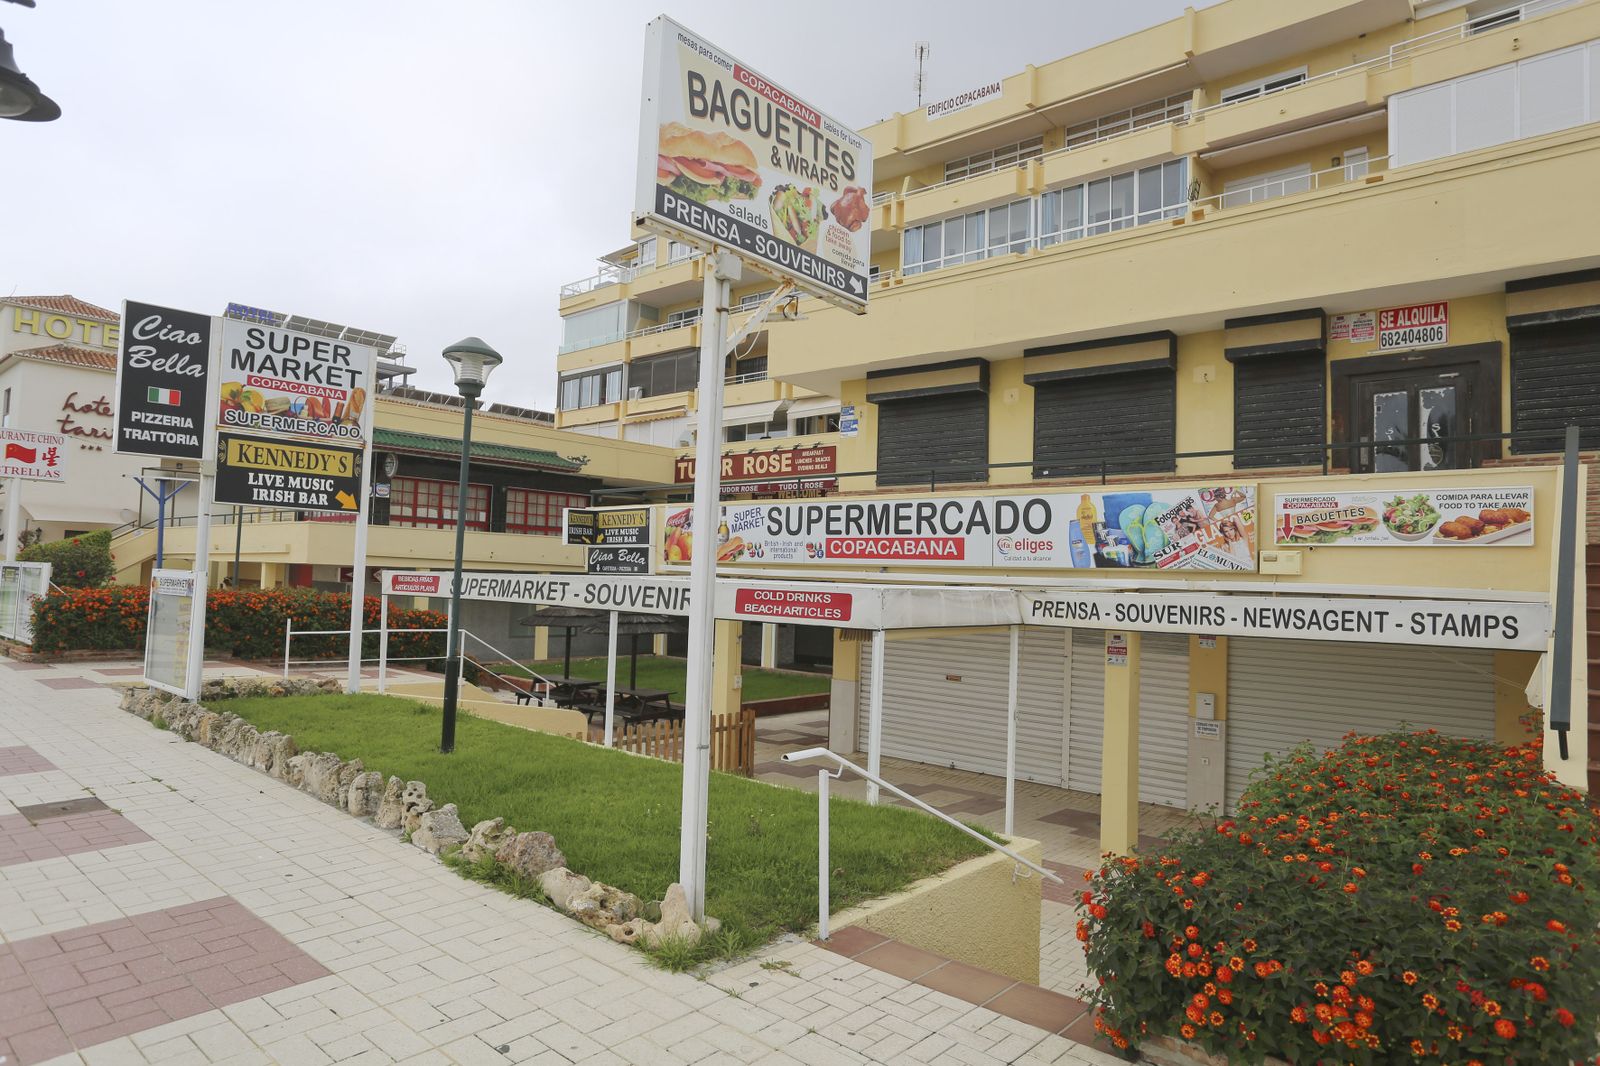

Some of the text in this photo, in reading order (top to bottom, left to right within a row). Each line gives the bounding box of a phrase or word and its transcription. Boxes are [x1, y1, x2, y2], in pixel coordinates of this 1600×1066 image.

[677, 32, 733, 72] mesas para comer
[739, 70, 818, 125] COPACABANA
[927, 98, 955, 116] EDIFICIO
[955, 82, 1001, 107] COPACABANA
[686, 69, 857, 183] BAGUETTES
[823, 119, 840, 137] tables
[840, 128, 848, 141] for
[770, 145, 839, 192] & WRAPS
[728, 203, 769, 230] salads
[663, 192, 741, 246] PRENSA
[755, 233, 846, 290] SOUVENIRS
[831, 248, 852, 261] comida
[1380, 304, 1446, 329] SE ALQUILA
[14, 307, 119, 349] HOTE
[131, 314, 203, 345] Ciao
[1381, 326, 1443, 347] 682404806
[245, 327, 351, 367] SUPER
[127, 344, 205, 378] Bella
[230, 348, 363, 390] MARKET
[250, 376, 345, 400] COPACABANA
[62, 391, 115, 417] hote
[130, 411, 194, 429] PIZZERIA
[223, 408, 362, 440] SUPERMERCADO
[37, 434, 65, 446] CHINO
[122, 427, 200, 447] TRATTORIA
[0, 465, 61, 479] TRELLAS
[677, 452, 793, 480] TUR ROSE
[247, 472, 335, 492] LIVE MUSIC
[740, 484, 759, 493] ROSE
[804, 481, 824, 489] ROSE
[252, 487, 329, 506] IRISH BAR
[1436, 493, 1469, 501] COMIDA
[1495, 492, 1529, 500] LLEVAR
[1439, 502, 1463, 510] FOOD
[1501, 501, 1527, 509] AWAY
[733, 507, 762, 523] SUPER
[766, 497, 1053, 536] SUPERMERCADO
[1154, 496, 1195, 526] Fotogramas
[1296, 507, 1366, 525] BAGUETTES
[605, 527, 640, 536] LIVE MUSIC
[730, 516, 766, 534] MARKET
[606, 535, 637, 544] IRISH BAR
[829, 539, 959, 556] COPACABANA
[1014, 537, 1054, 554] eliges
[589, 548, 646, 565] Ciao Bella
[1153, 541, 1181, 561] SUR
[1197, 548, 1209, 560] EL
[583, 582, 691, 611] SOUVENIR
[753, 590, 832, 604] COLD DRINKS
[744, 602, 842, 619] BEACH ARTICLES
[1032, 600, 1101, 621] PRENSA
[1115, 602, 1226, 627] SOUVENIRS
[1243, 607, 1390, 633] NEWSAGENT
[1409, 611, 1519, 640] STAMPS
